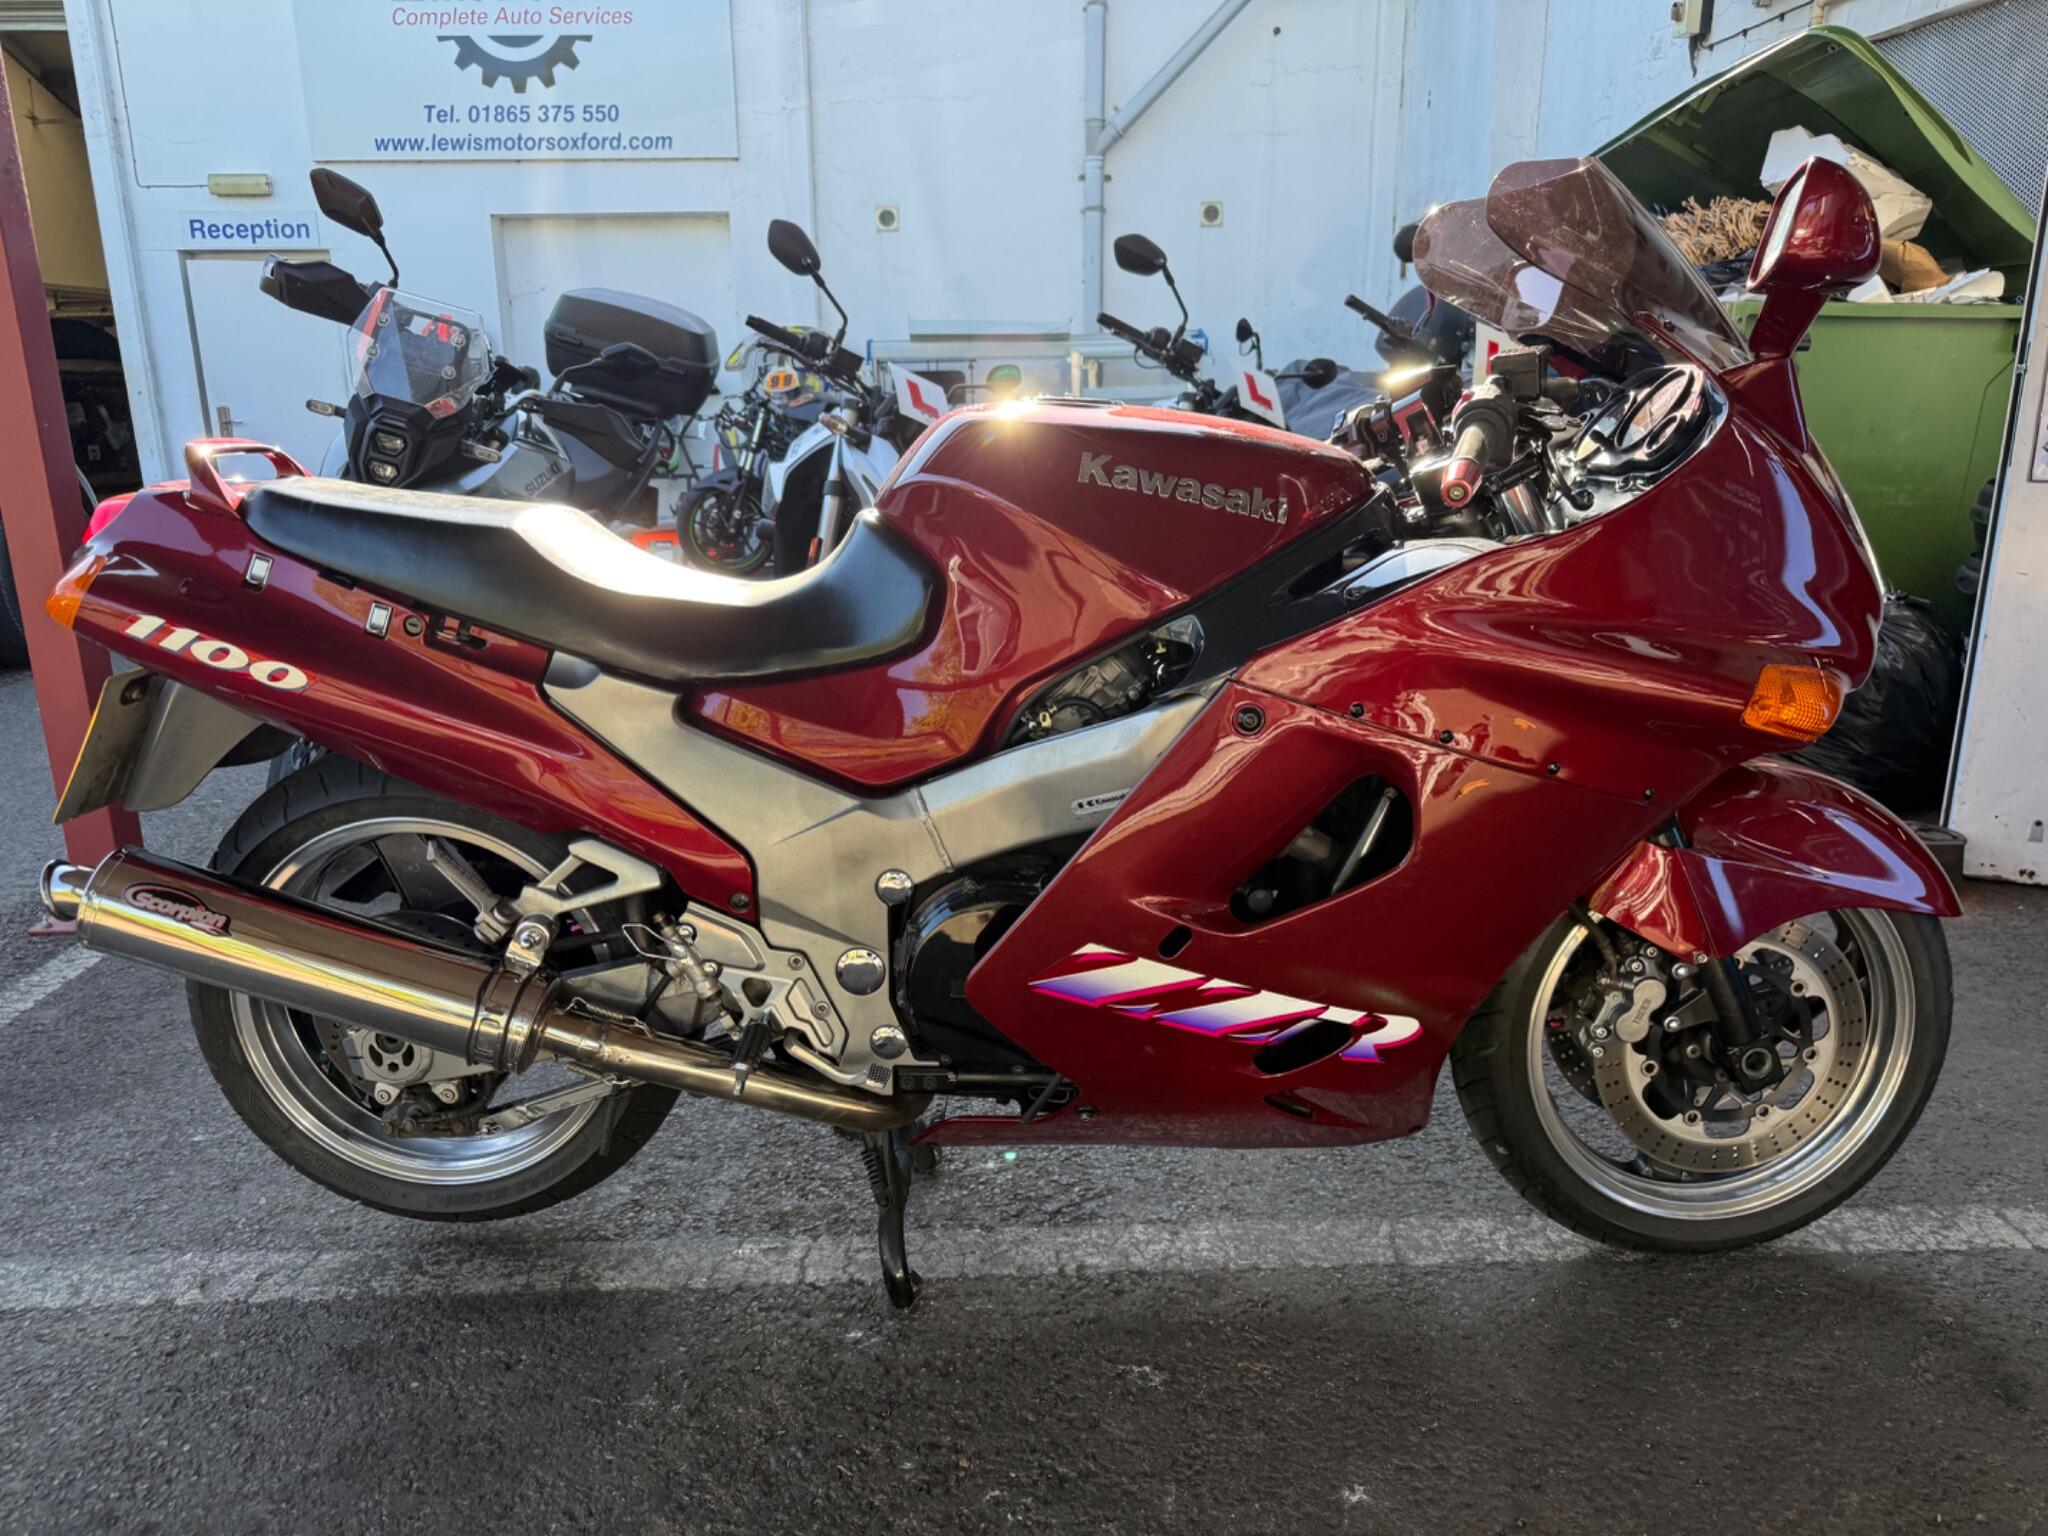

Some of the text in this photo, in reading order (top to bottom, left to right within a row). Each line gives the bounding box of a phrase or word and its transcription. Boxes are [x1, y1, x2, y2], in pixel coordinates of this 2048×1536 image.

[392, 6, 633, 28] Complete Auto Services
[424, 104, 620, 124] Tel. 01865 375 550
[374, 132, 673, 152] www.lewismotorsoxford.com
[188, 218, 310, 244] Reception
[1077, 451, 1288, 525] Kawasaki
[124, 613, 310, 690] 1100
